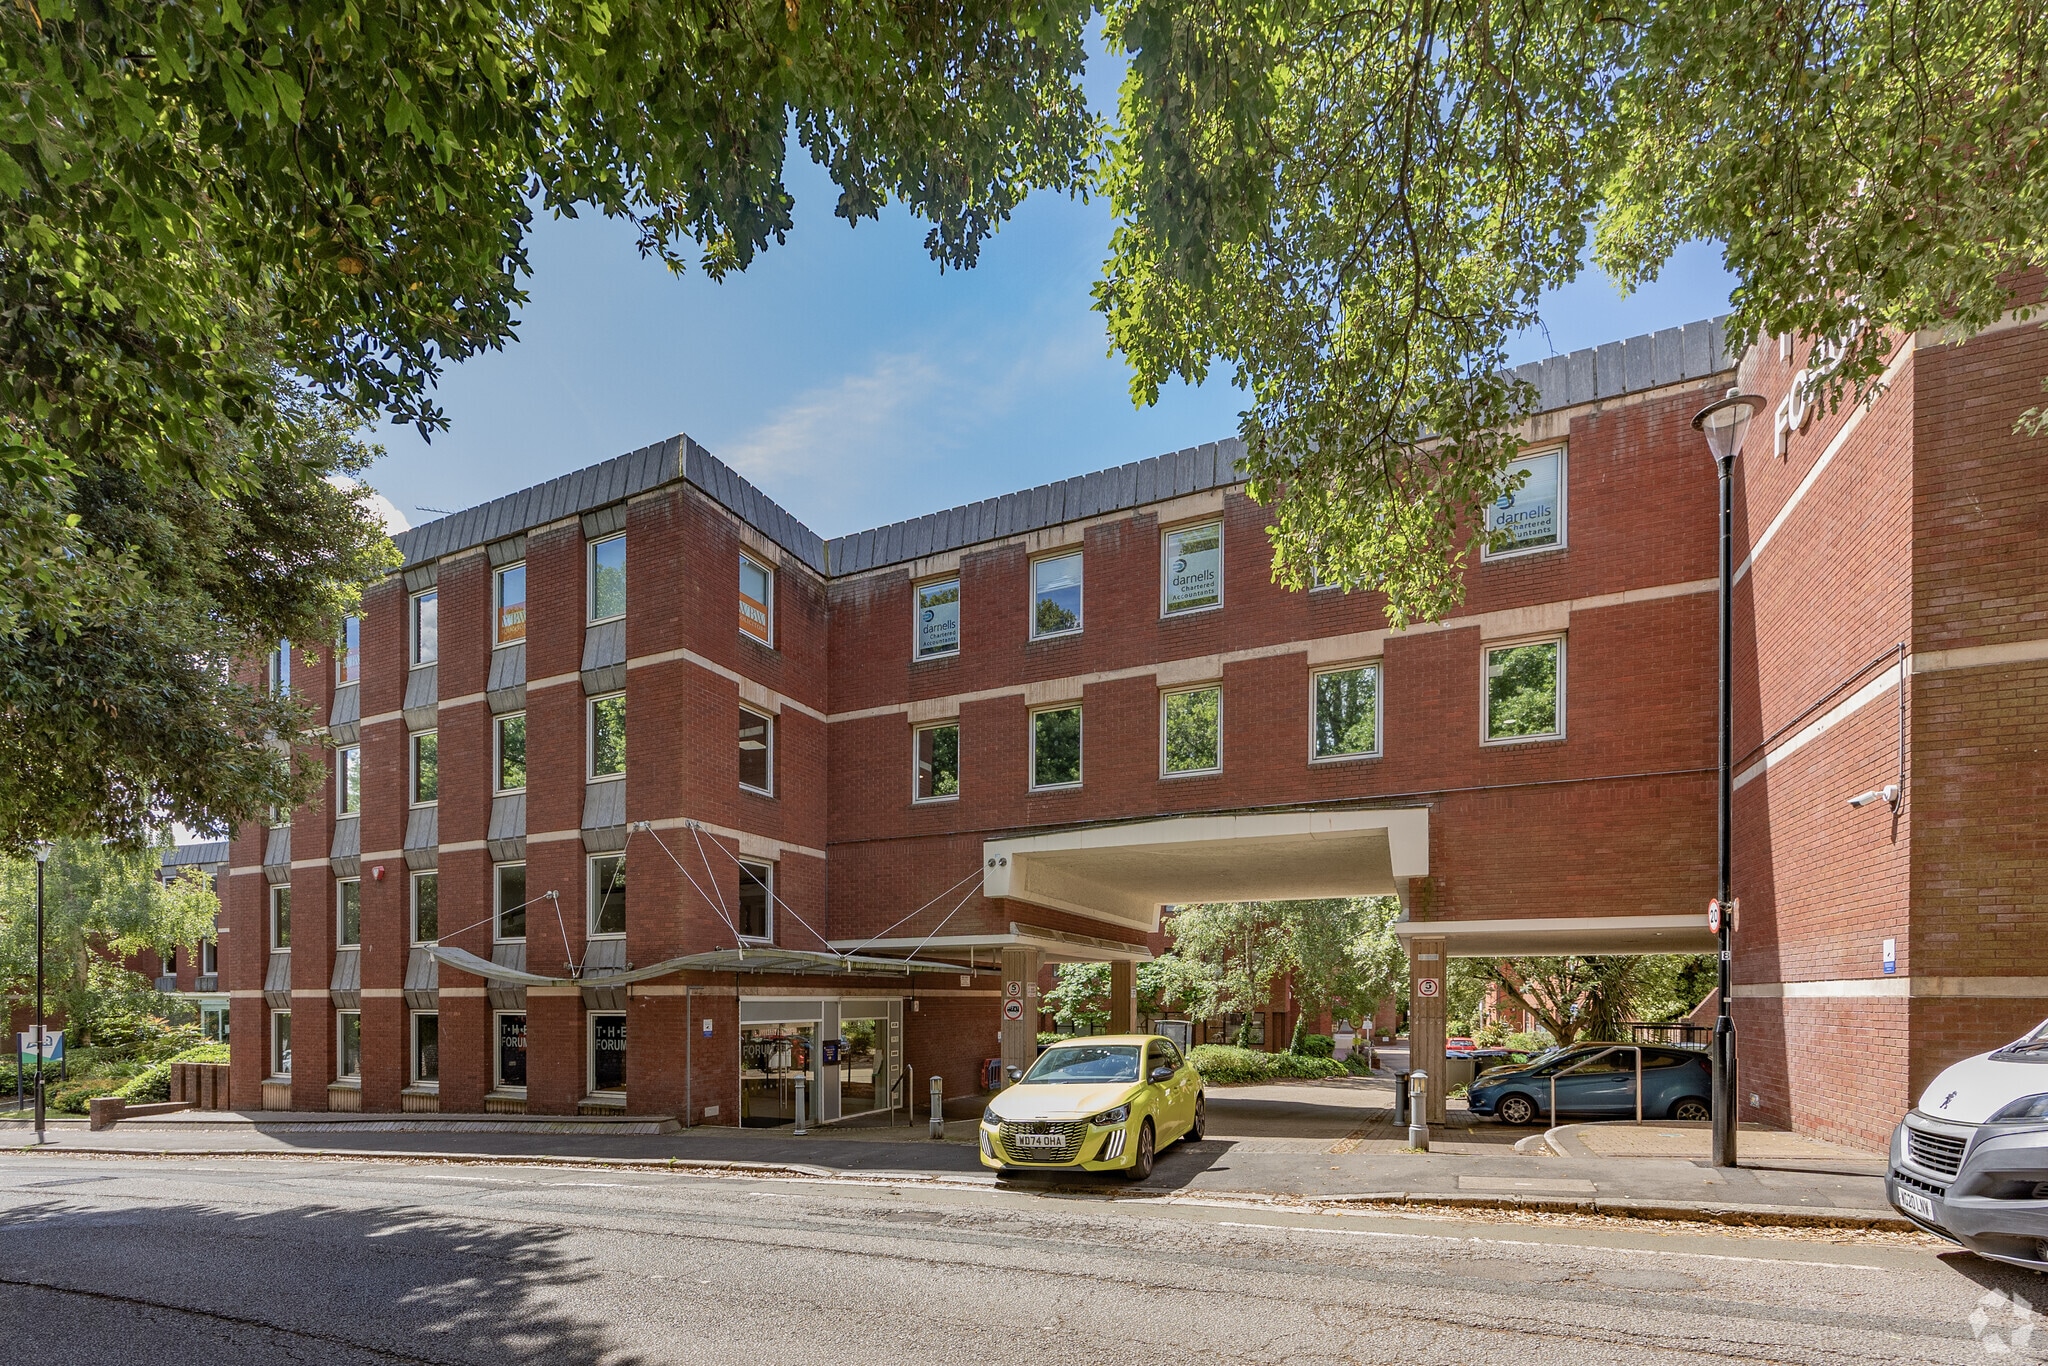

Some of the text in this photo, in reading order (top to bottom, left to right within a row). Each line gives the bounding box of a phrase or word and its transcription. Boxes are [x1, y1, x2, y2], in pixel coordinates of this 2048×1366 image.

[1496, 505, 1552, 525] darnells
[1172, 569, 1215, 586] darnells
[1181, 581, 1215, 592] Chartered
[1172, 589, 1215, 600] Accountants
[923, 620, 956, 634] darnells
[929, 630, 956, 639] Chartered
[923, 637, 956, 647] Accountants
[1710, 909, 1717, 923] 20
[1425, 981, 1431, 989] 5
[596, 1039, 627, 1051] FORUM
[1019, 1136, 1061, 1145] WD74 OHA
